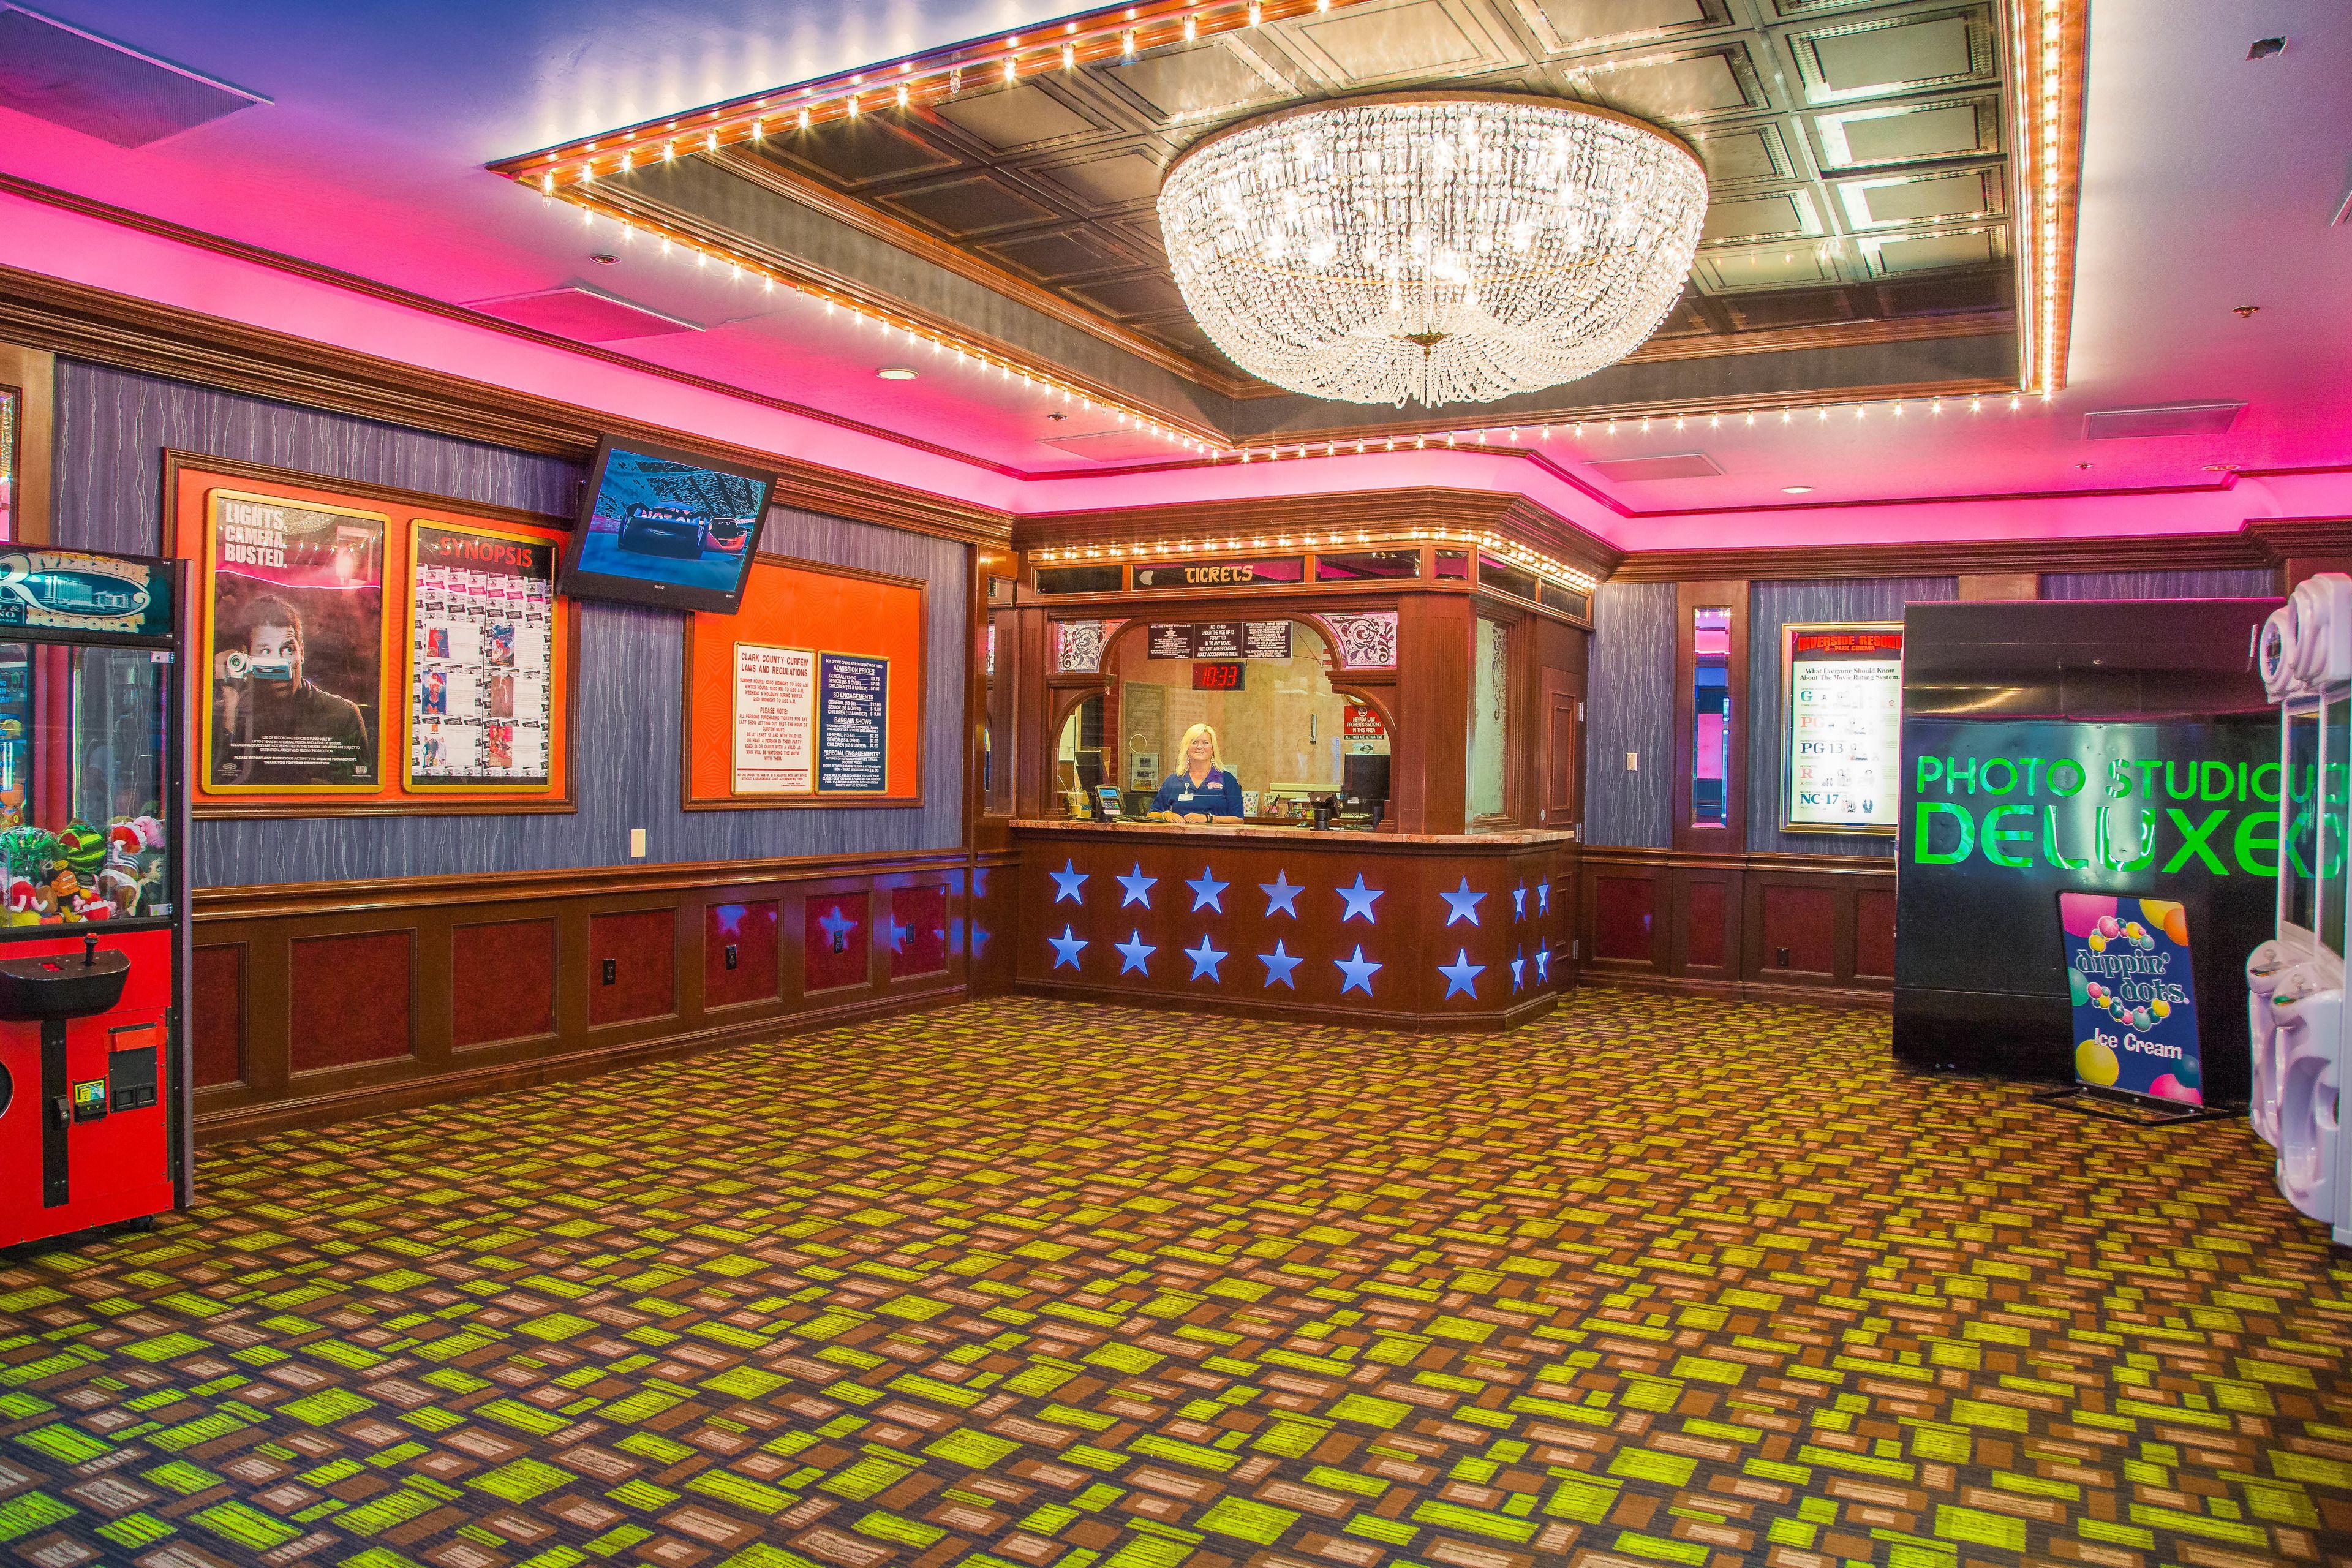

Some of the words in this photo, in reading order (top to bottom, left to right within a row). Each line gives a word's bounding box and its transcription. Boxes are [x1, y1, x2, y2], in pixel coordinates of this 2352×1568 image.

[225, 543, 287, 568] BUSTED.
[440, 537, 533, 567] SYNOPSIS
[26, 605, 145, 633] RESORT
[1798, 636, 1855, 651] RIVERSIDE
[1858, 636, 1902, 649] RESORT
[741, 652, 759, 662] CLARK
[763, 654, 784, 664] COUNTY
[786, 657, 809, 666] CURFEW
[772, 666, 808, 677] REGULATIONS
[1202, 666, 1237, 686] 10:33
[1801, 690, 1812, 701] G
[1800, 717, 1824, 728] PG
[1800, 742, 1824, 753] PG
[1830, 744, 1843, 753] 13
[1800, 768, 1813, 778] R
[1917, 756, 2086, 796] PHOTO
[2105, 759, 2283, 802] STUDIO
[1800, 794, 1839, 804] NC-17
[1915, 802, 2280, 877] DELUXE
[2075, 949, 2171, 978] dippin'
[2094, 1028, 2118, 1048] Ice
[2124, 1033, 2182, 1060] Cream
